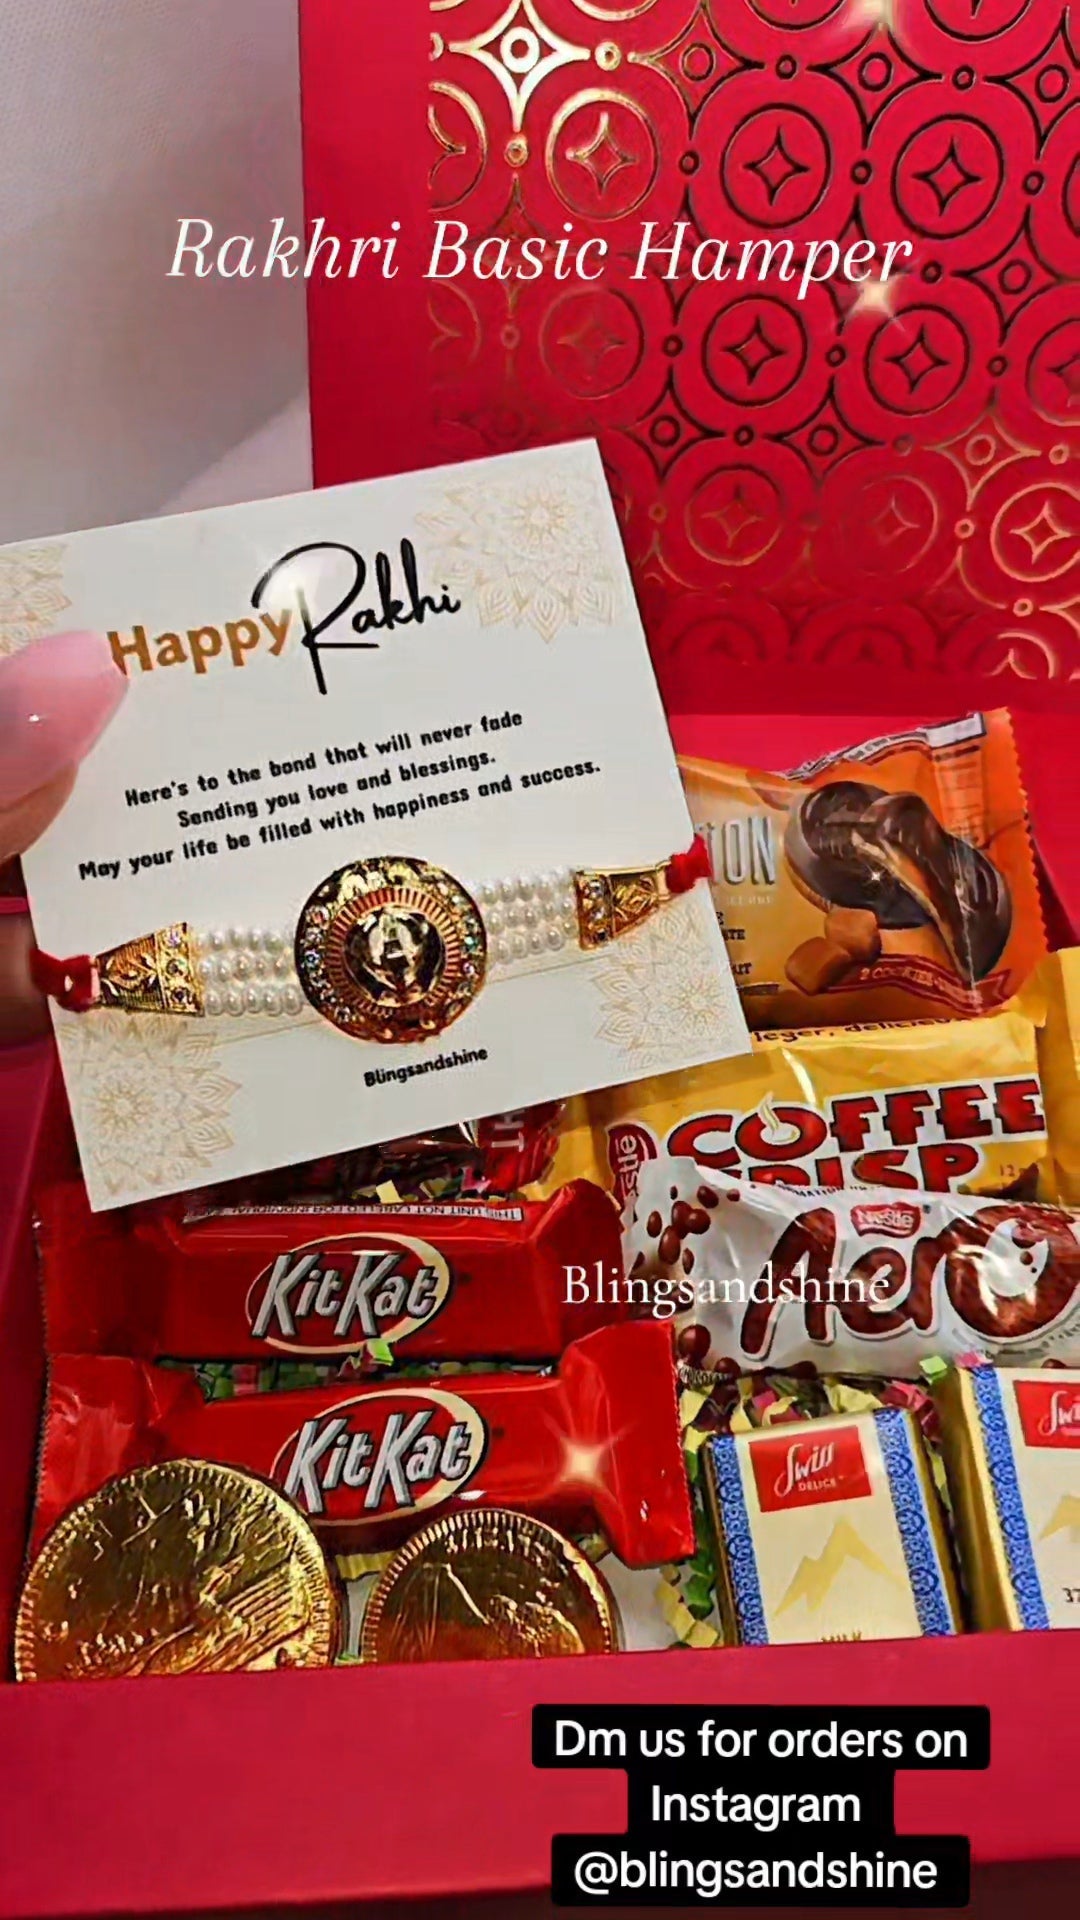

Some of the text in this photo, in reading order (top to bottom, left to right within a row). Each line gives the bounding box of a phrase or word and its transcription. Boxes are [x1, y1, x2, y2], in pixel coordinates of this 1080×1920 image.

[107, 538, 461, 695] Happy Rakhi
[124, 711, 523, 807] Here's to the bond that will never fade
[177, 752, 496, 828] Sending you love and blessings.
[78, 761, 601, 881] May your life be filled with happiness and success.
[694, 816, 776, 886] ION
[363, 1048, 488, 1087] Blingsandshine
[667, 1078, 1046, 1169] COFFEE
[717, 1142, 980, 1192] ISP
[740, 1203, 1079, 1355] Aero
